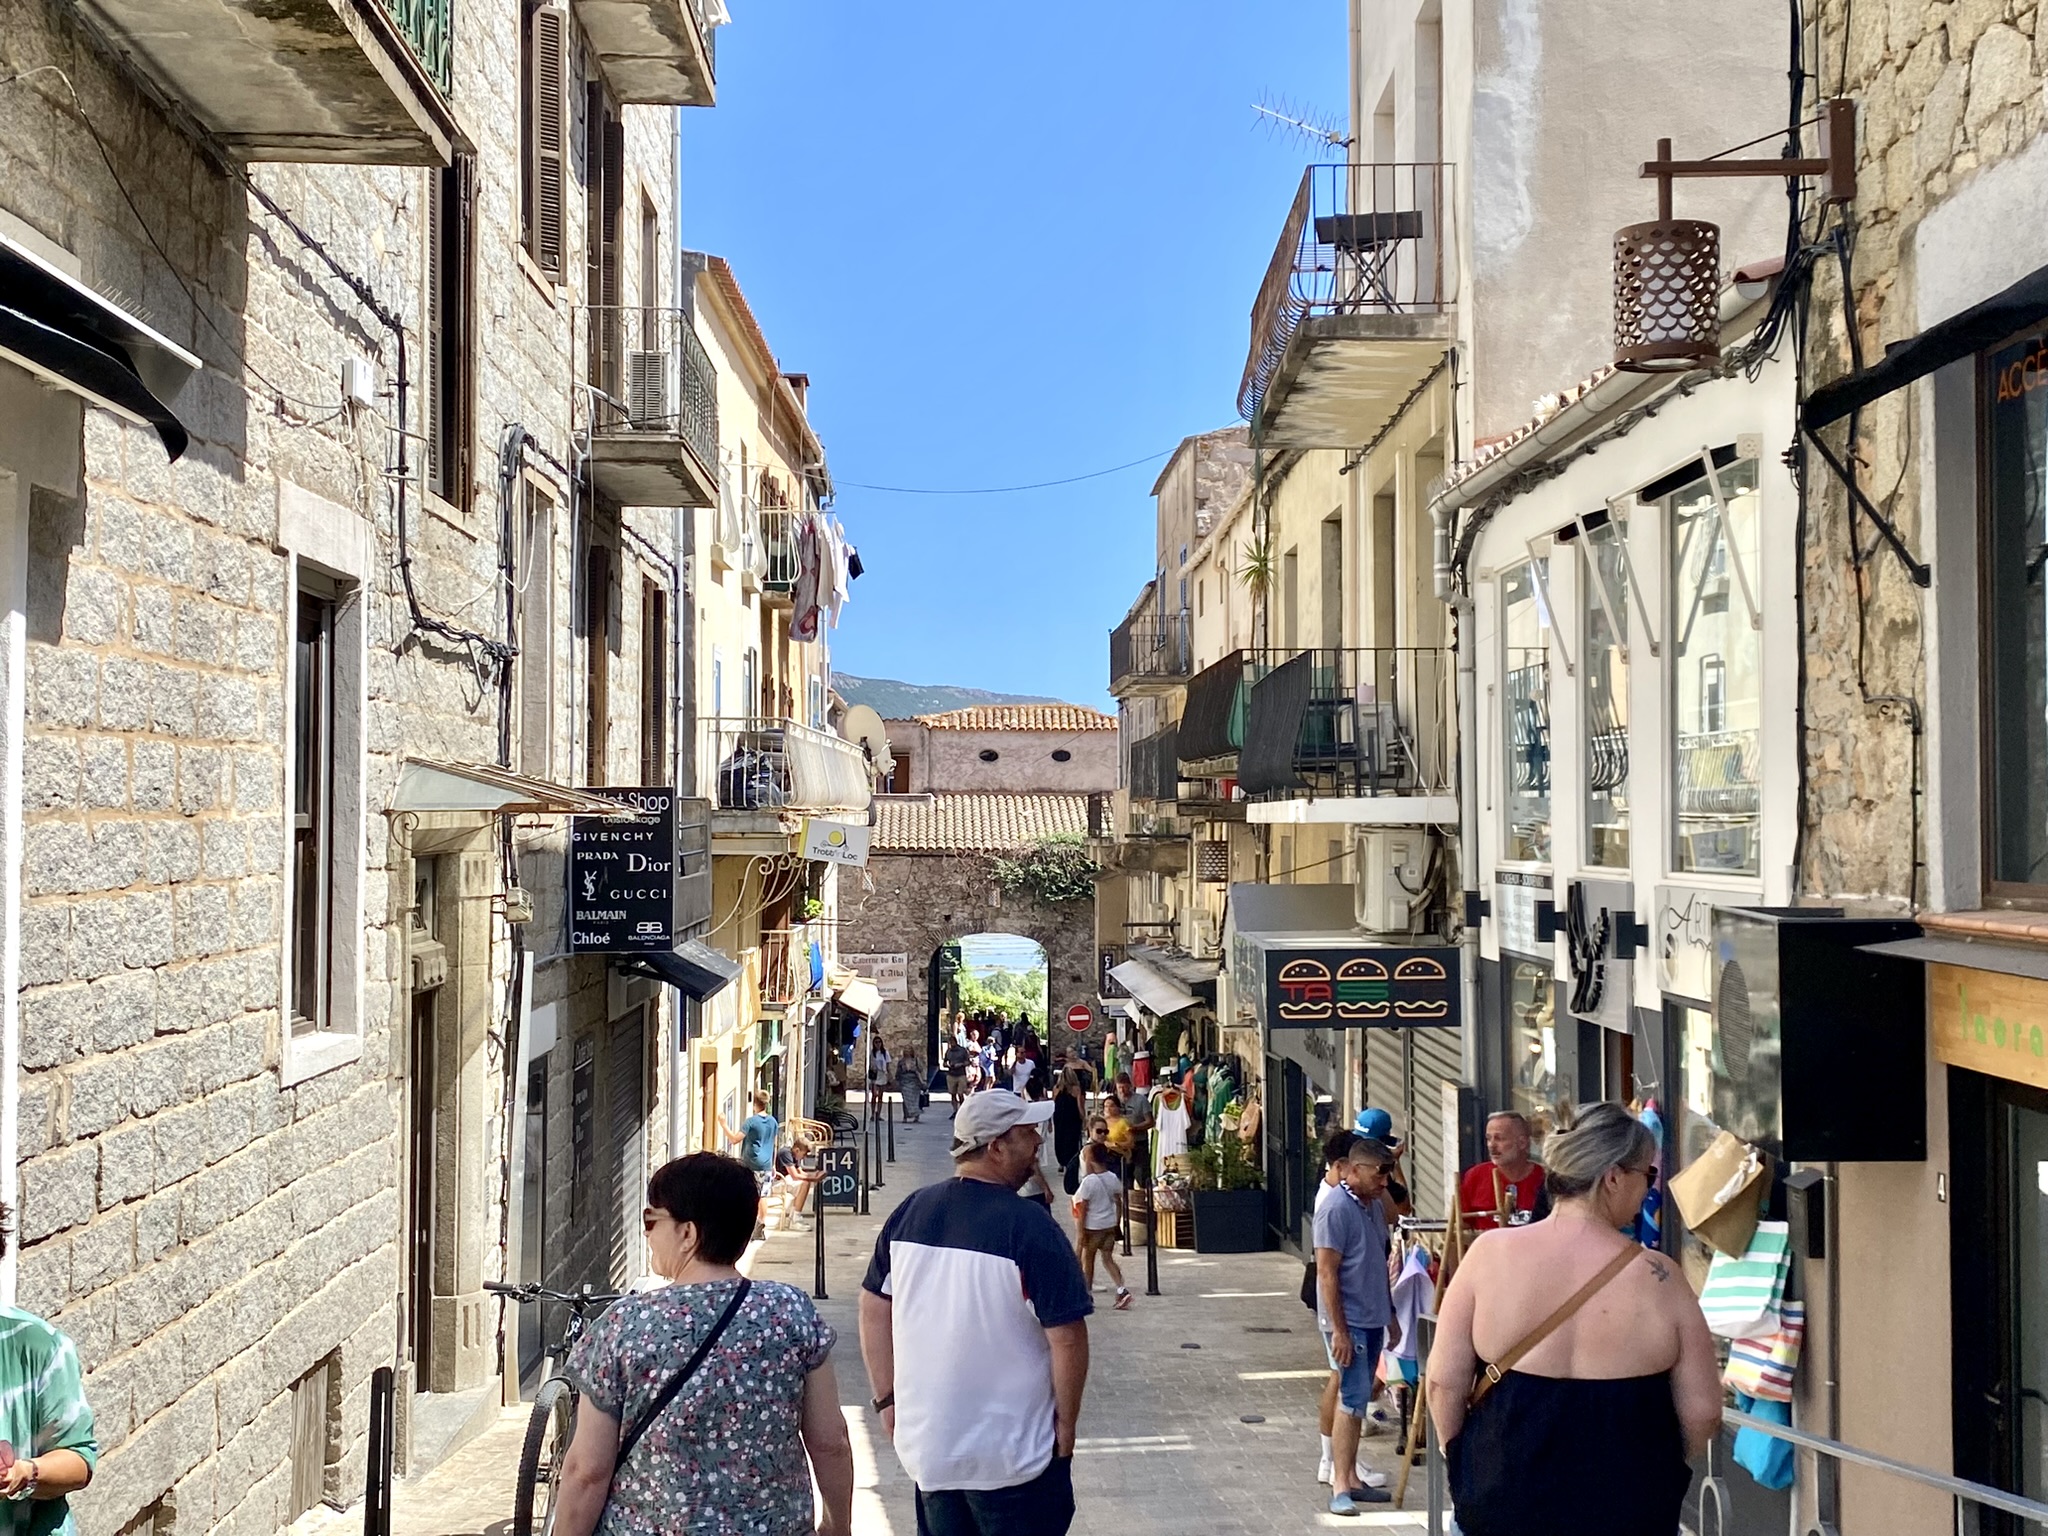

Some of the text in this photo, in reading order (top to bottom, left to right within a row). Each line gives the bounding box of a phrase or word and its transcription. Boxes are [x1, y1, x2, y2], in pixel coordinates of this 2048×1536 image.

[628, 792, 670, 813] Shop
[573, 832, 654, 841] GIVENCHY
[577, 851, 619, 860] PRADA
[842, 851, 858, 861] Loc
[626, 853, 672, 872] Dior
[610, 889, 667, 899] GUCCI
[576, 910, 627, 920] BALMAIN
[572, 931, 611, 945] Chloé
[822, 1174, 856, 1196] CBD
